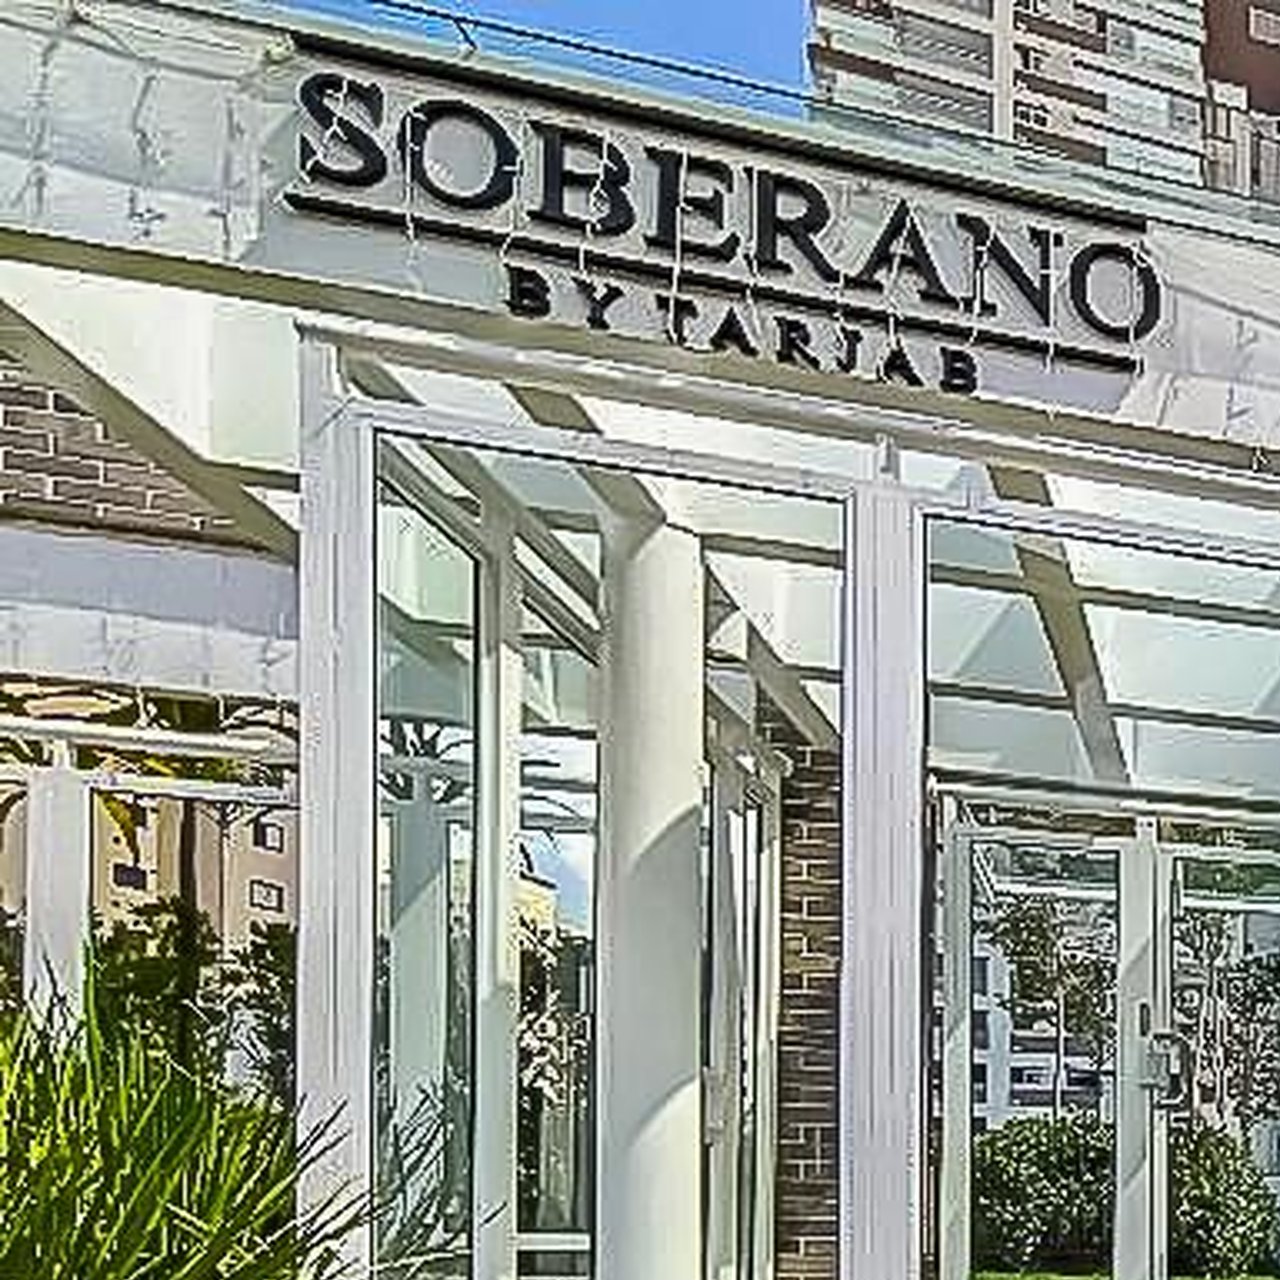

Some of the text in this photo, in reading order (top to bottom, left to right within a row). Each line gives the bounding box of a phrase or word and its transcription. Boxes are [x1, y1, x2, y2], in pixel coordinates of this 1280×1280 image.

[298, 72, 1162, 342] SOBERANO
[504, 263, 978, 396] BY TARJAB
